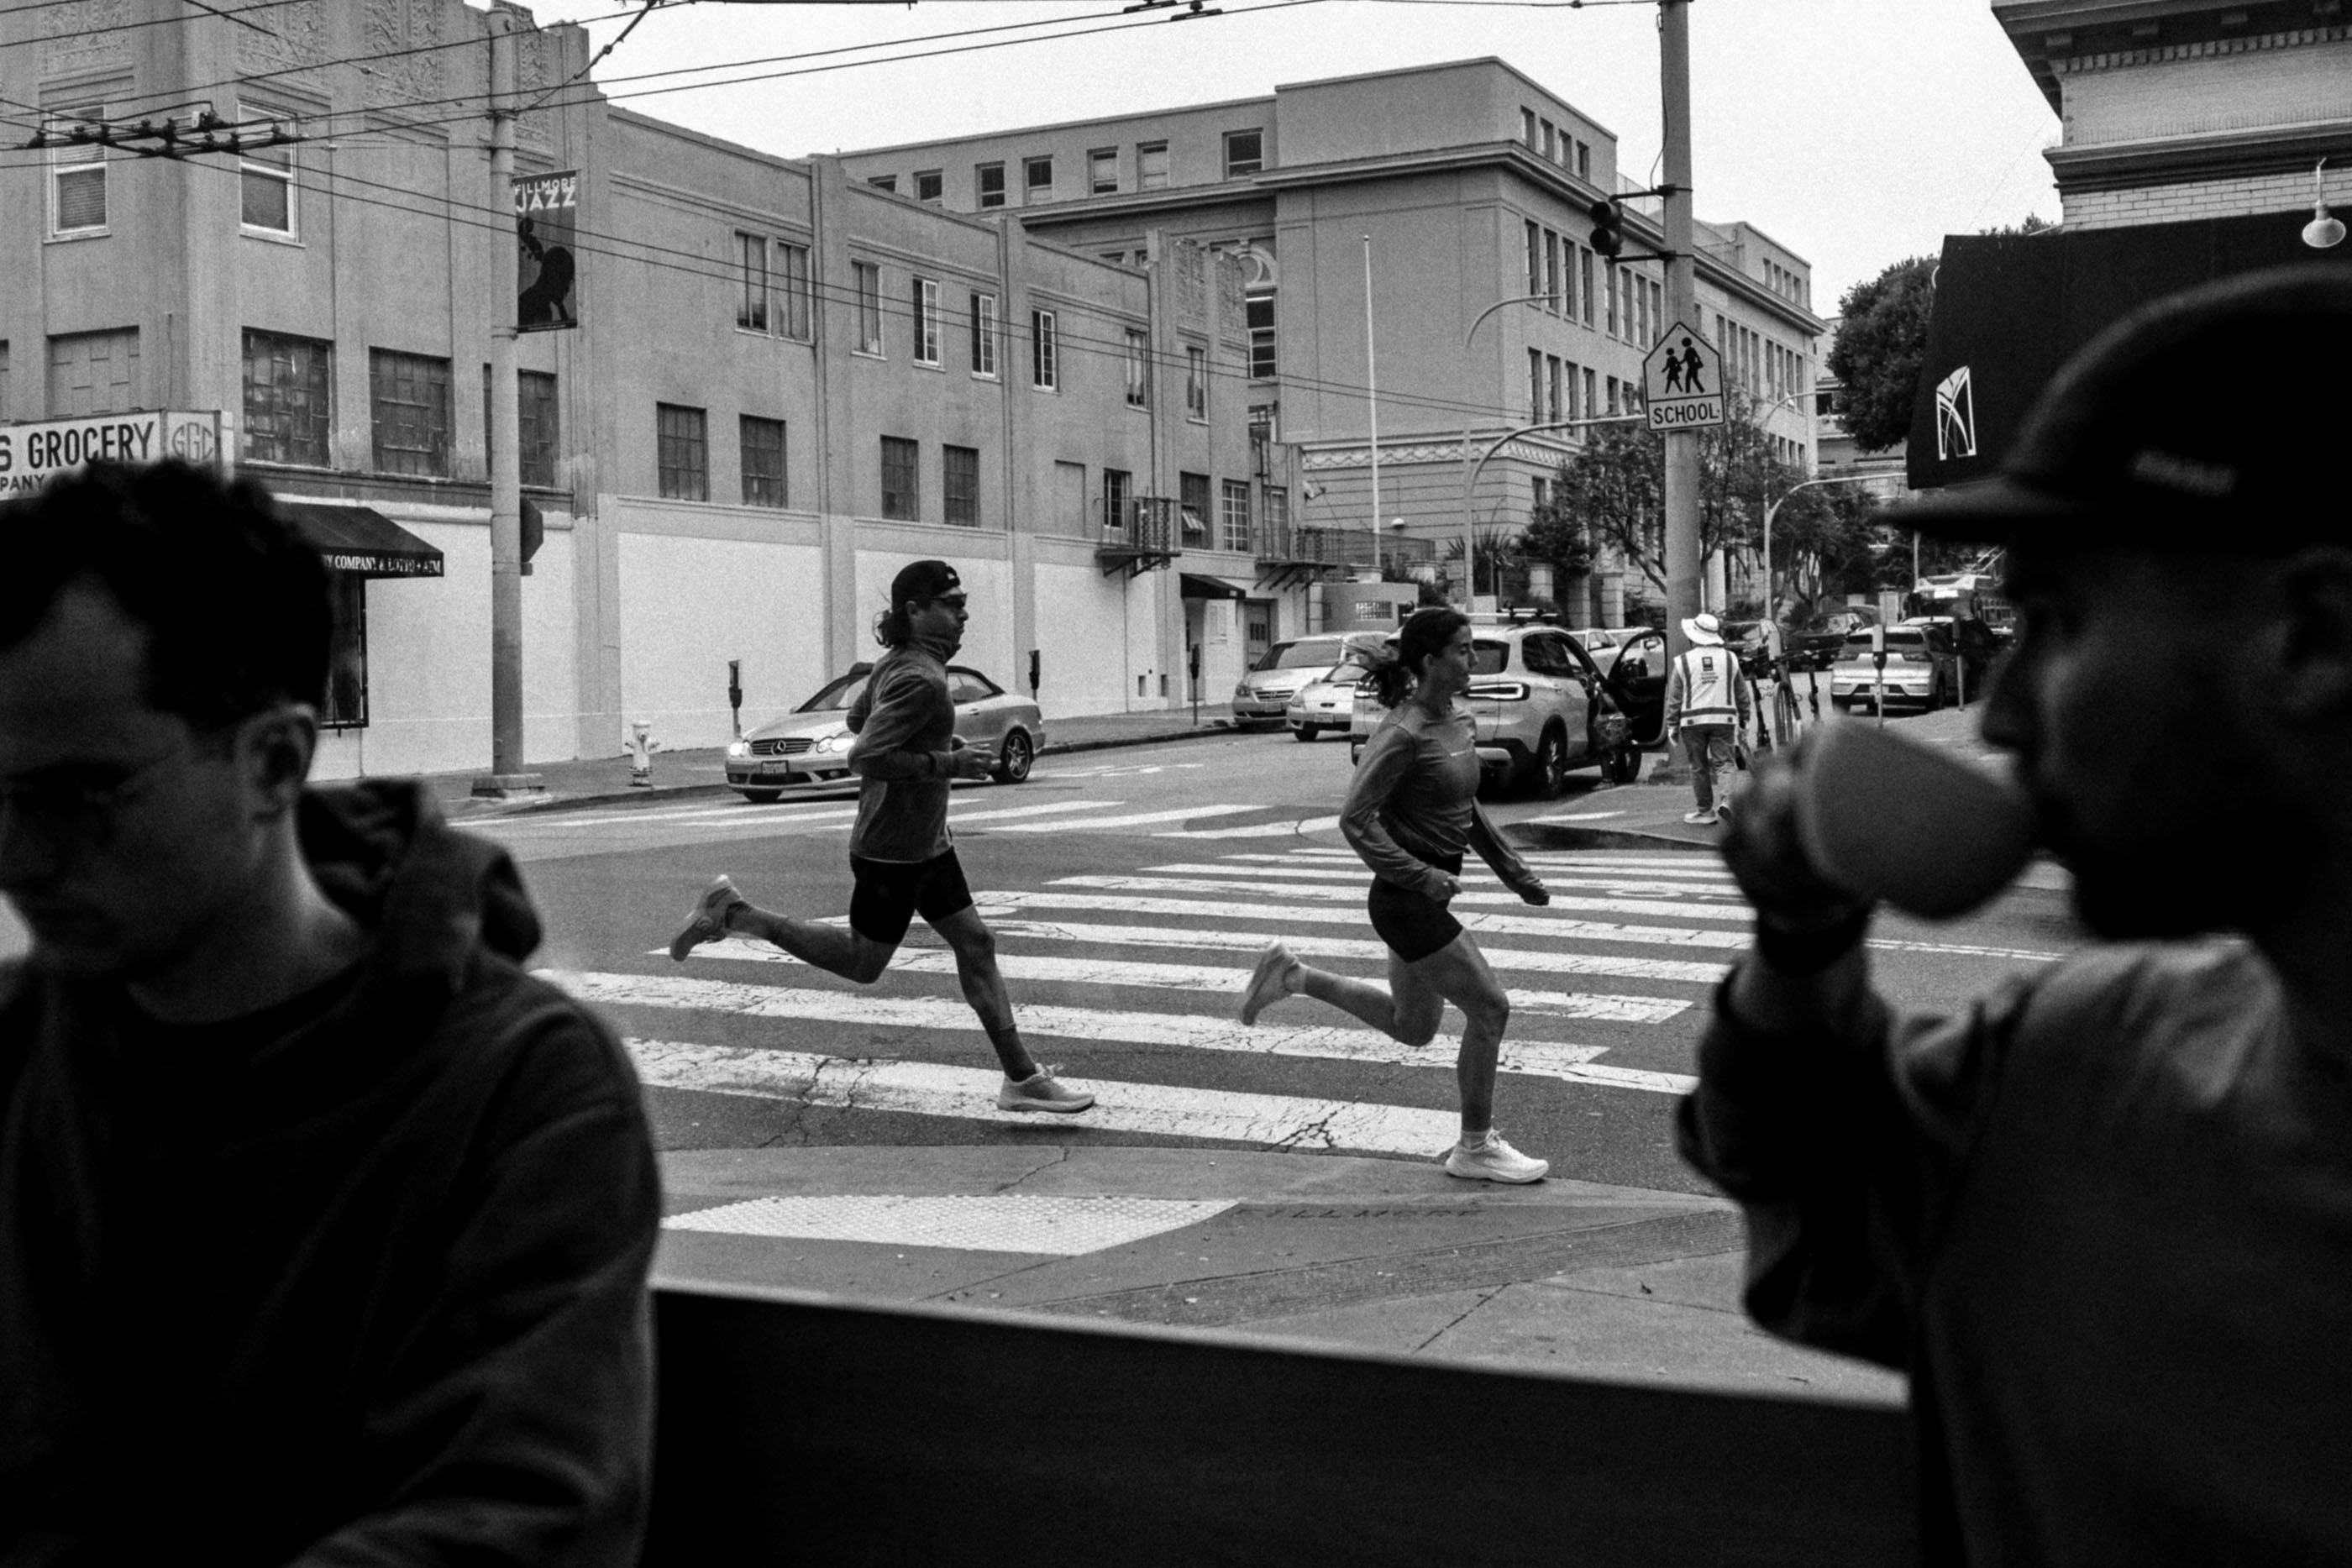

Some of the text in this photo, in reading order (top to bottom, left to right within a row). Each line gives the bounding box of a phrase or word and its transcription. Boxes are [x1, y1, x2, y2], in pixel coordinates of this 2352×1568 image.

[514, 177, 576, 195] FILLMORE
[515, 184, 576, 212] JAZZ
[1653, 402, 1719, 424] SCHOOL
[28, 421, 155, 469] GROCERY
[334, 555, 377, 571] COMPANY
